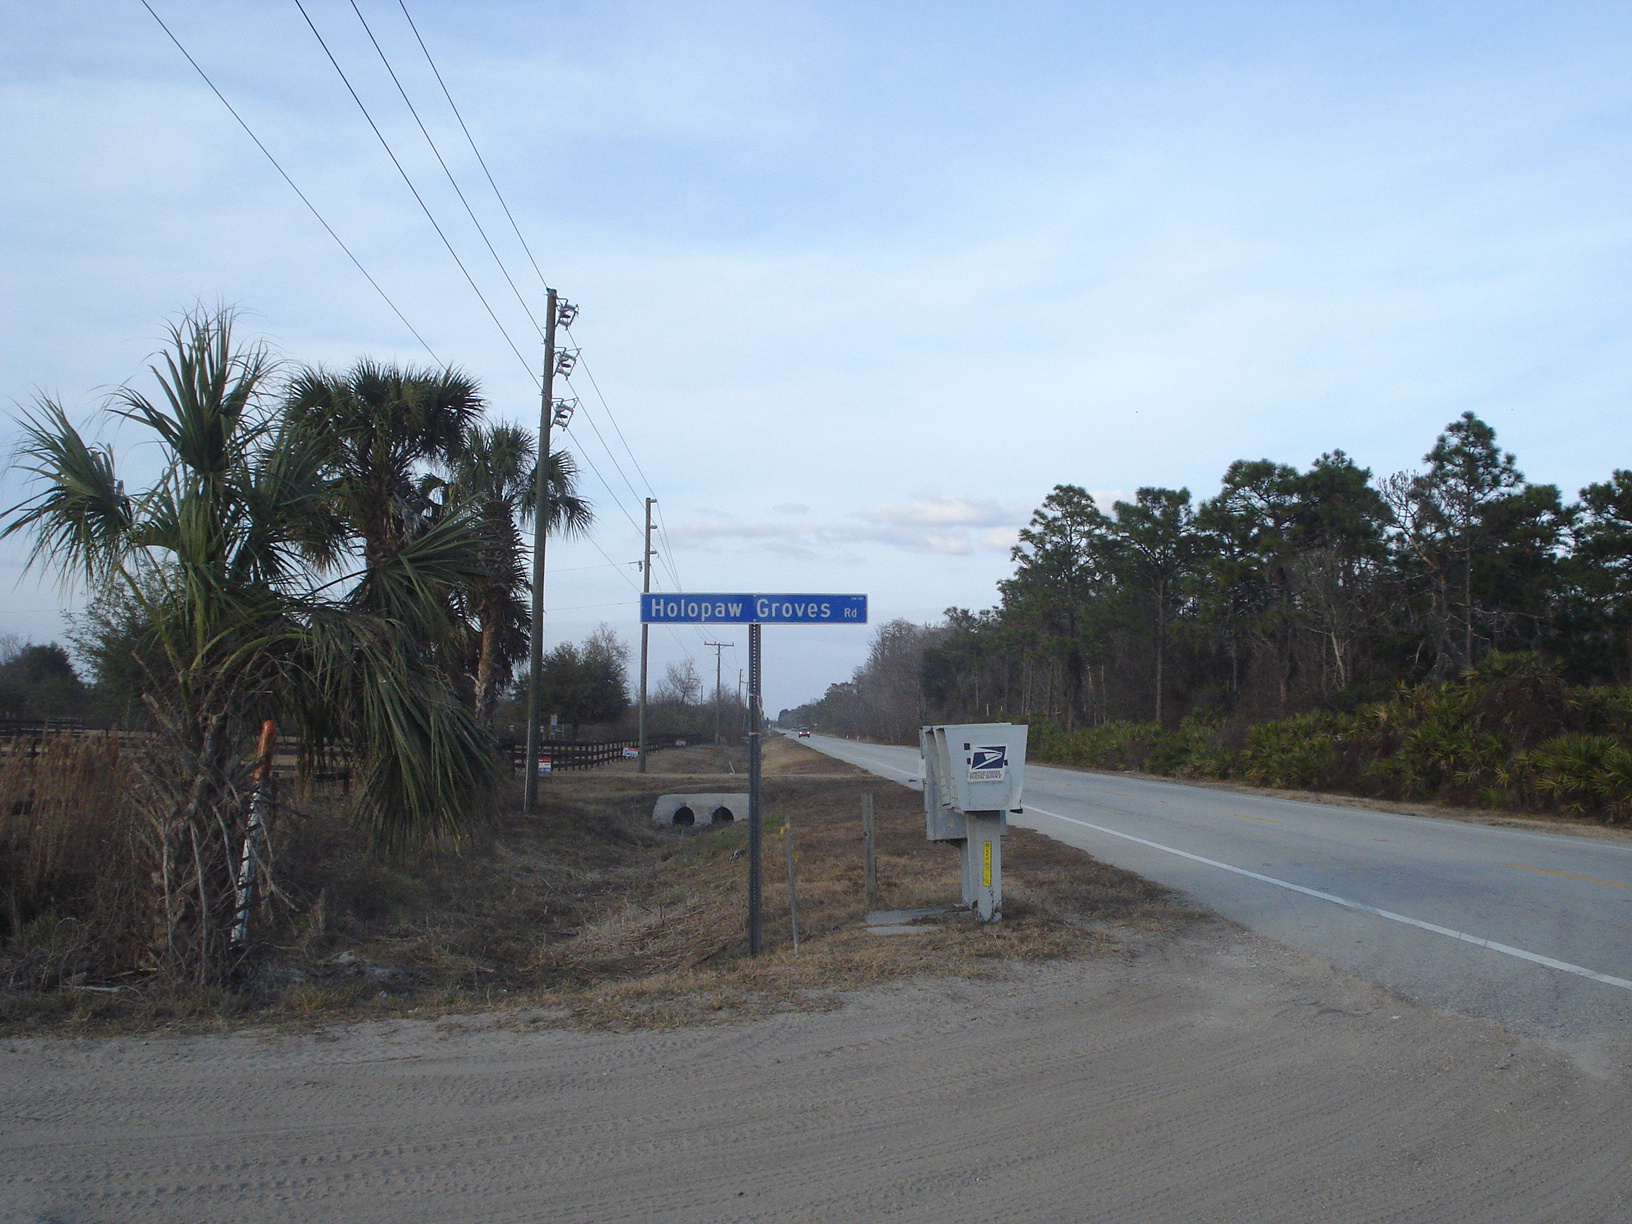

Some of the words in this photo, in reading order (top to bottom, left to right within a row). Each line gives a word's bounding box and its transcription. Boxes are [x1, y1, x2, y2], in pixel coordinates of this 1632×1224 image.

[651, 598, 743, 622] Holopaw
[756, 598, 831, 618] Groves
[844, 607, 857, 618] Rd
